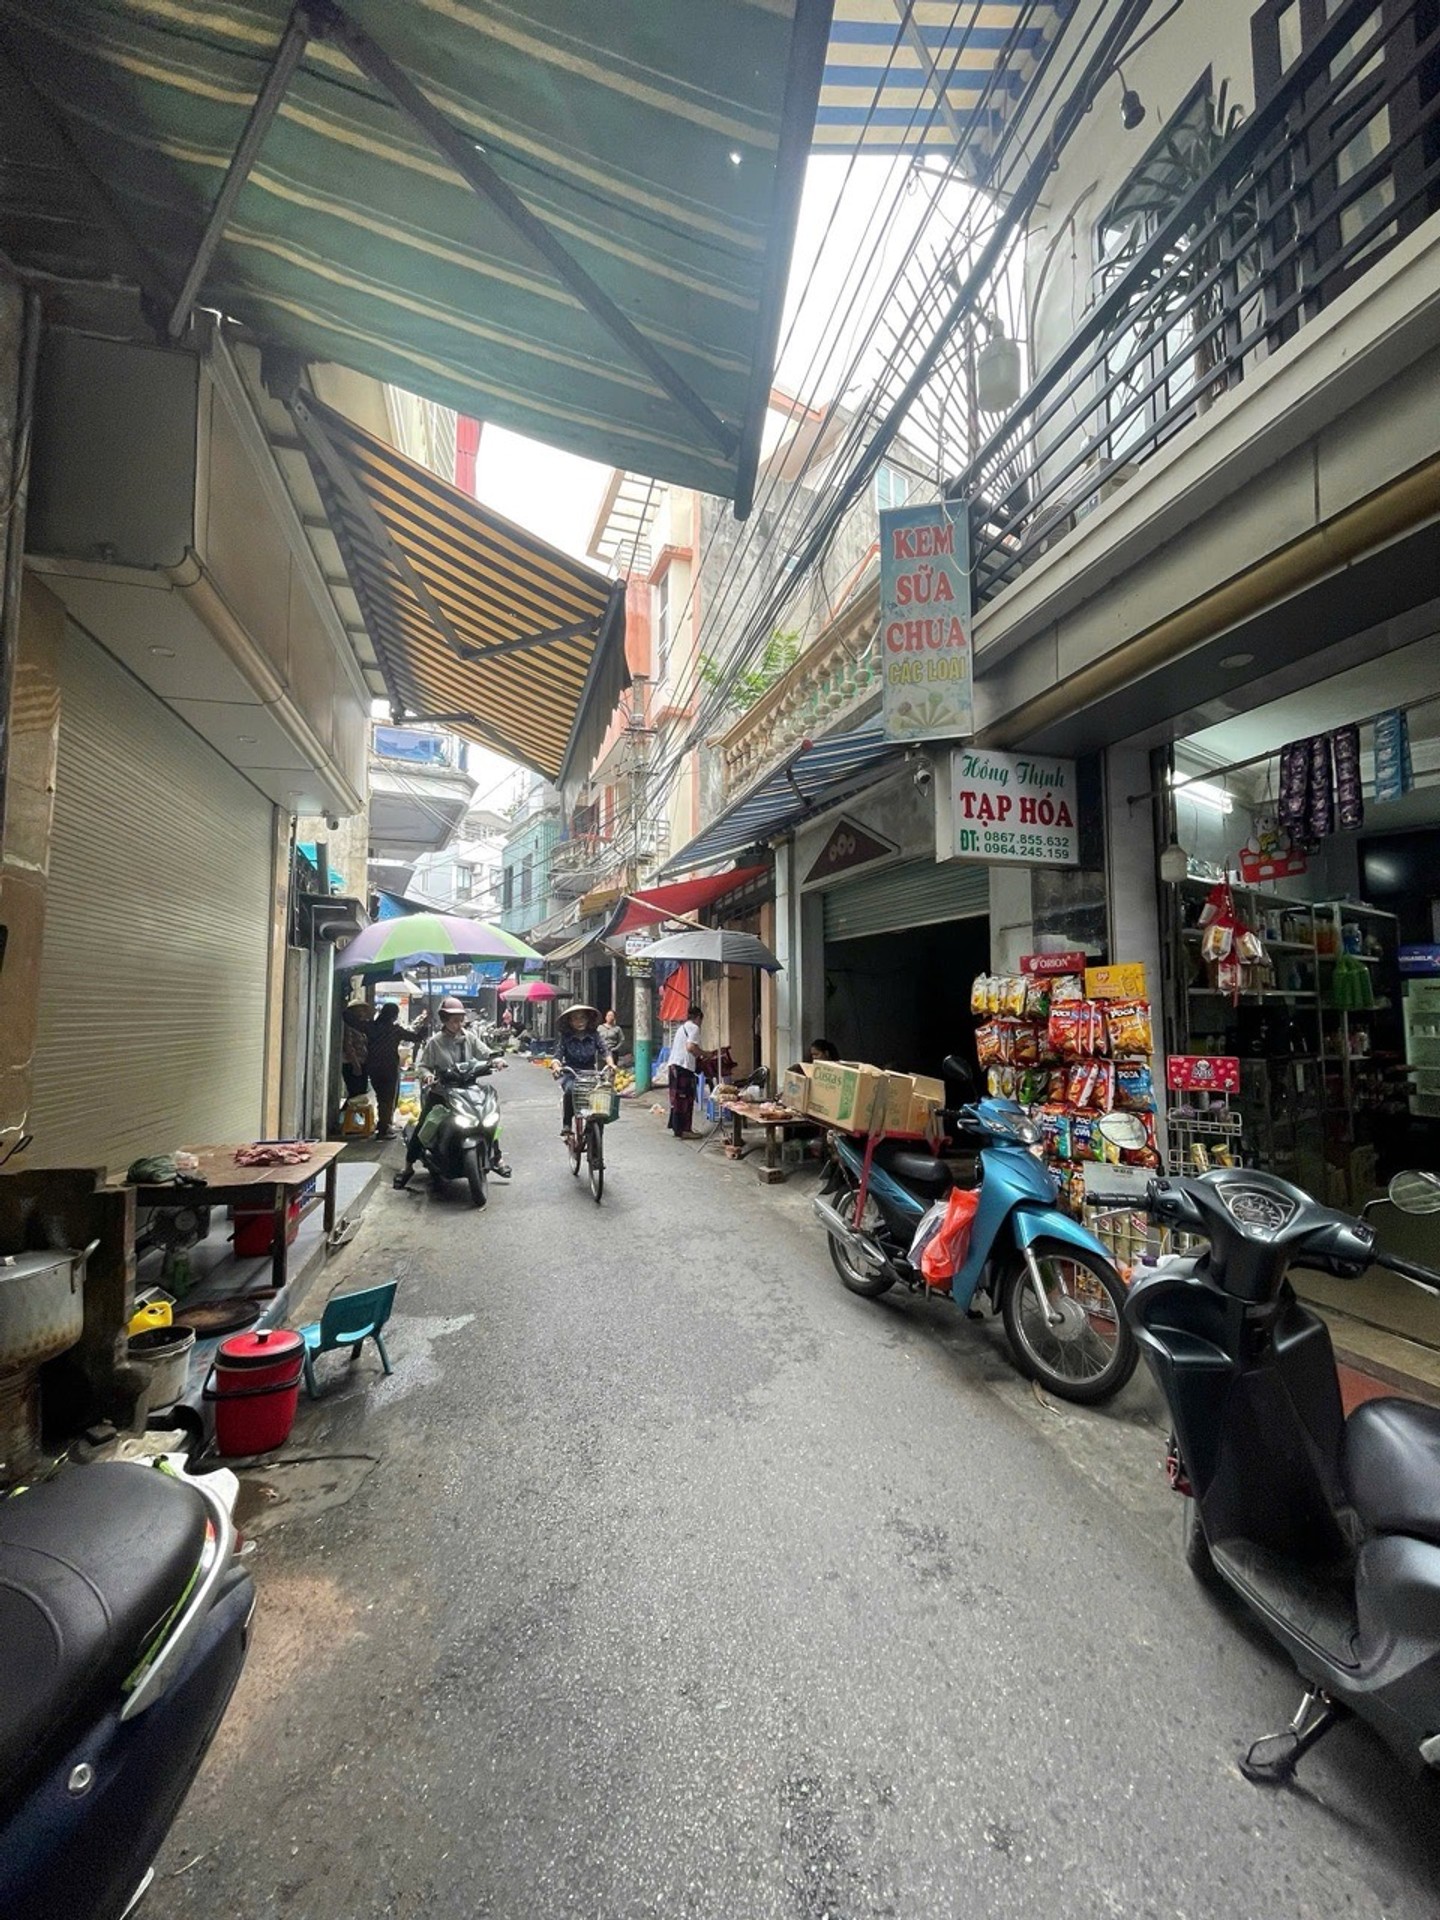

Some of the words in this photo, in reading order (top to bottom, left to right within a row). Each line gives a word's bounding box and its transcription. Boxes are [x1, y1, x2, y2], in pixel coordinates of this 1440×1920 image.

[893, 523, 955, 560] KEM
[896, 563, 955, 606] SỮA
[926, 655, 967, 685] LOẠI
[961, 754, 1010, 787] Hồng
[1016, 761, 1067, 789] Thịnh
[960, 791, 1012, 828] TẠP
[1019, 791, 1074, 828] HÓA
[1039, 959, 1069, 969] ORION
[1118, 1070, 1140, 1079] POCA
